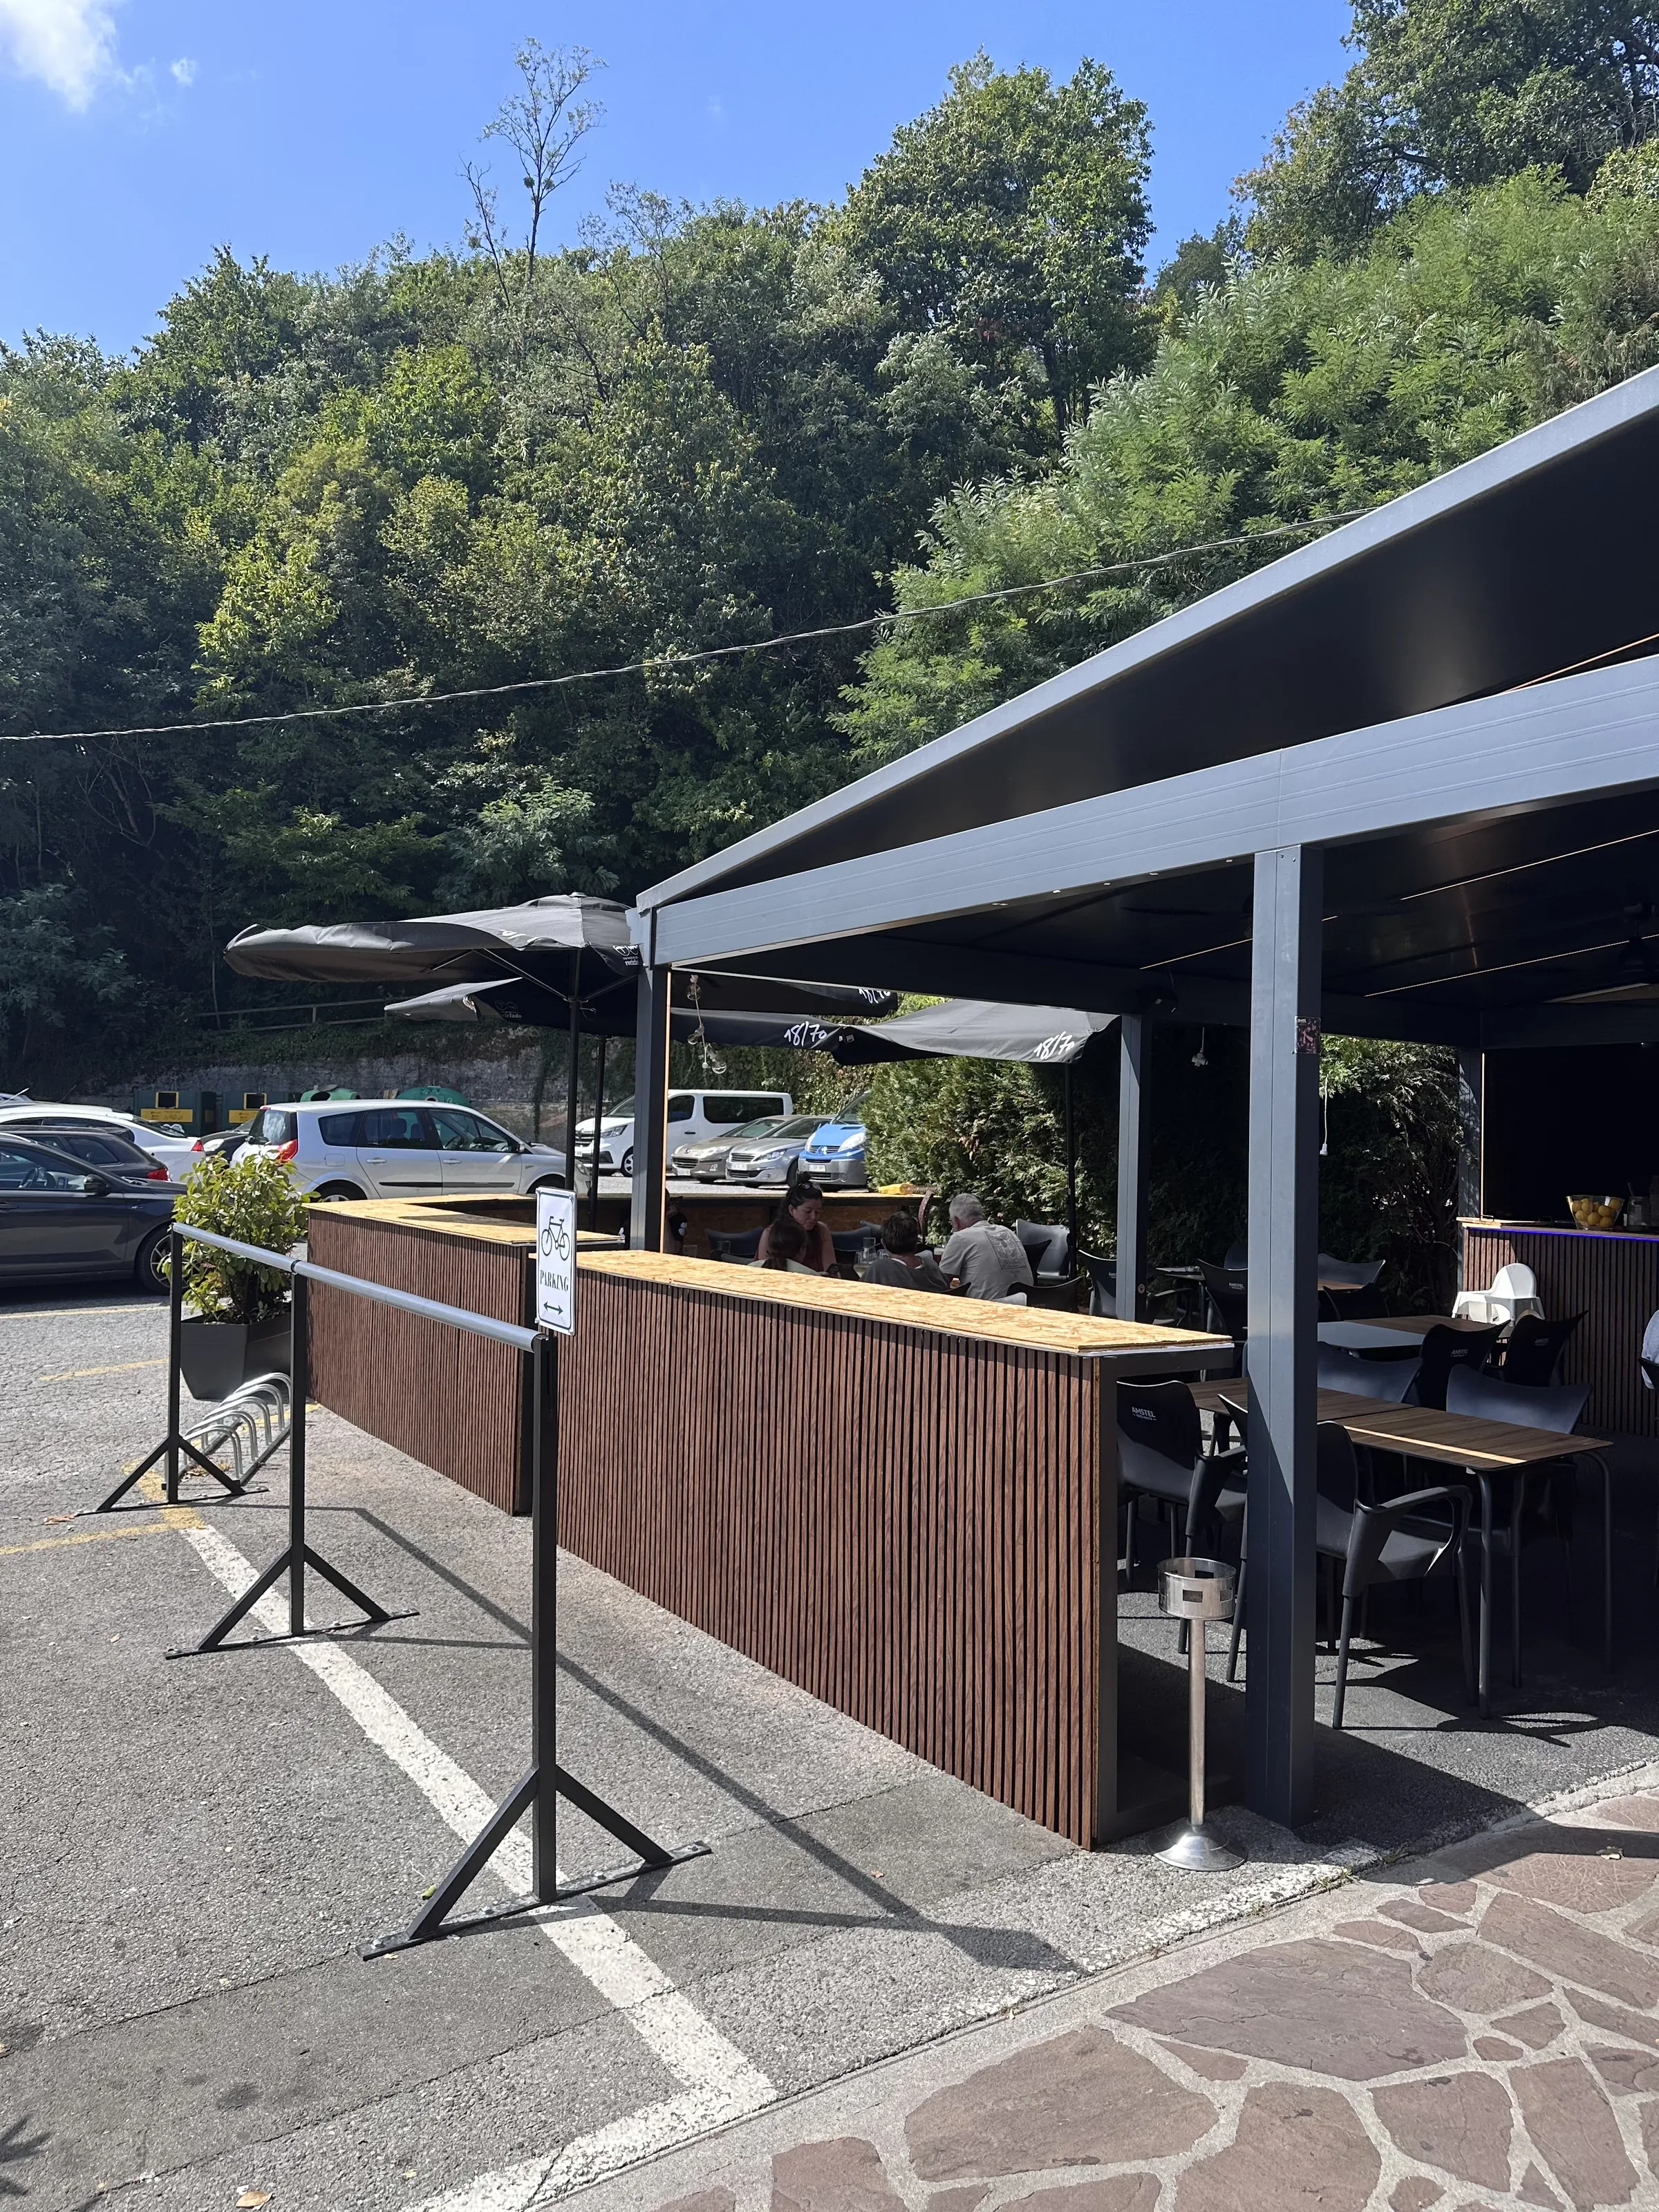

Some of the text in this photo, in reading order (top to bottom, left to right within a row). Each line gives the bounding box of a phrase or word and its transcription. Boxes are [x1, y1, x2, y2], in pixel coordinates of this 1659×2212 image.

[783, 1021, 827, 1047] 18/70
[1033, 1031, 1075, 1060] 18/70
[540, 1269, 569, 1292] PARKING
[1132, 1406, 1156, 1418] AMSTEL
